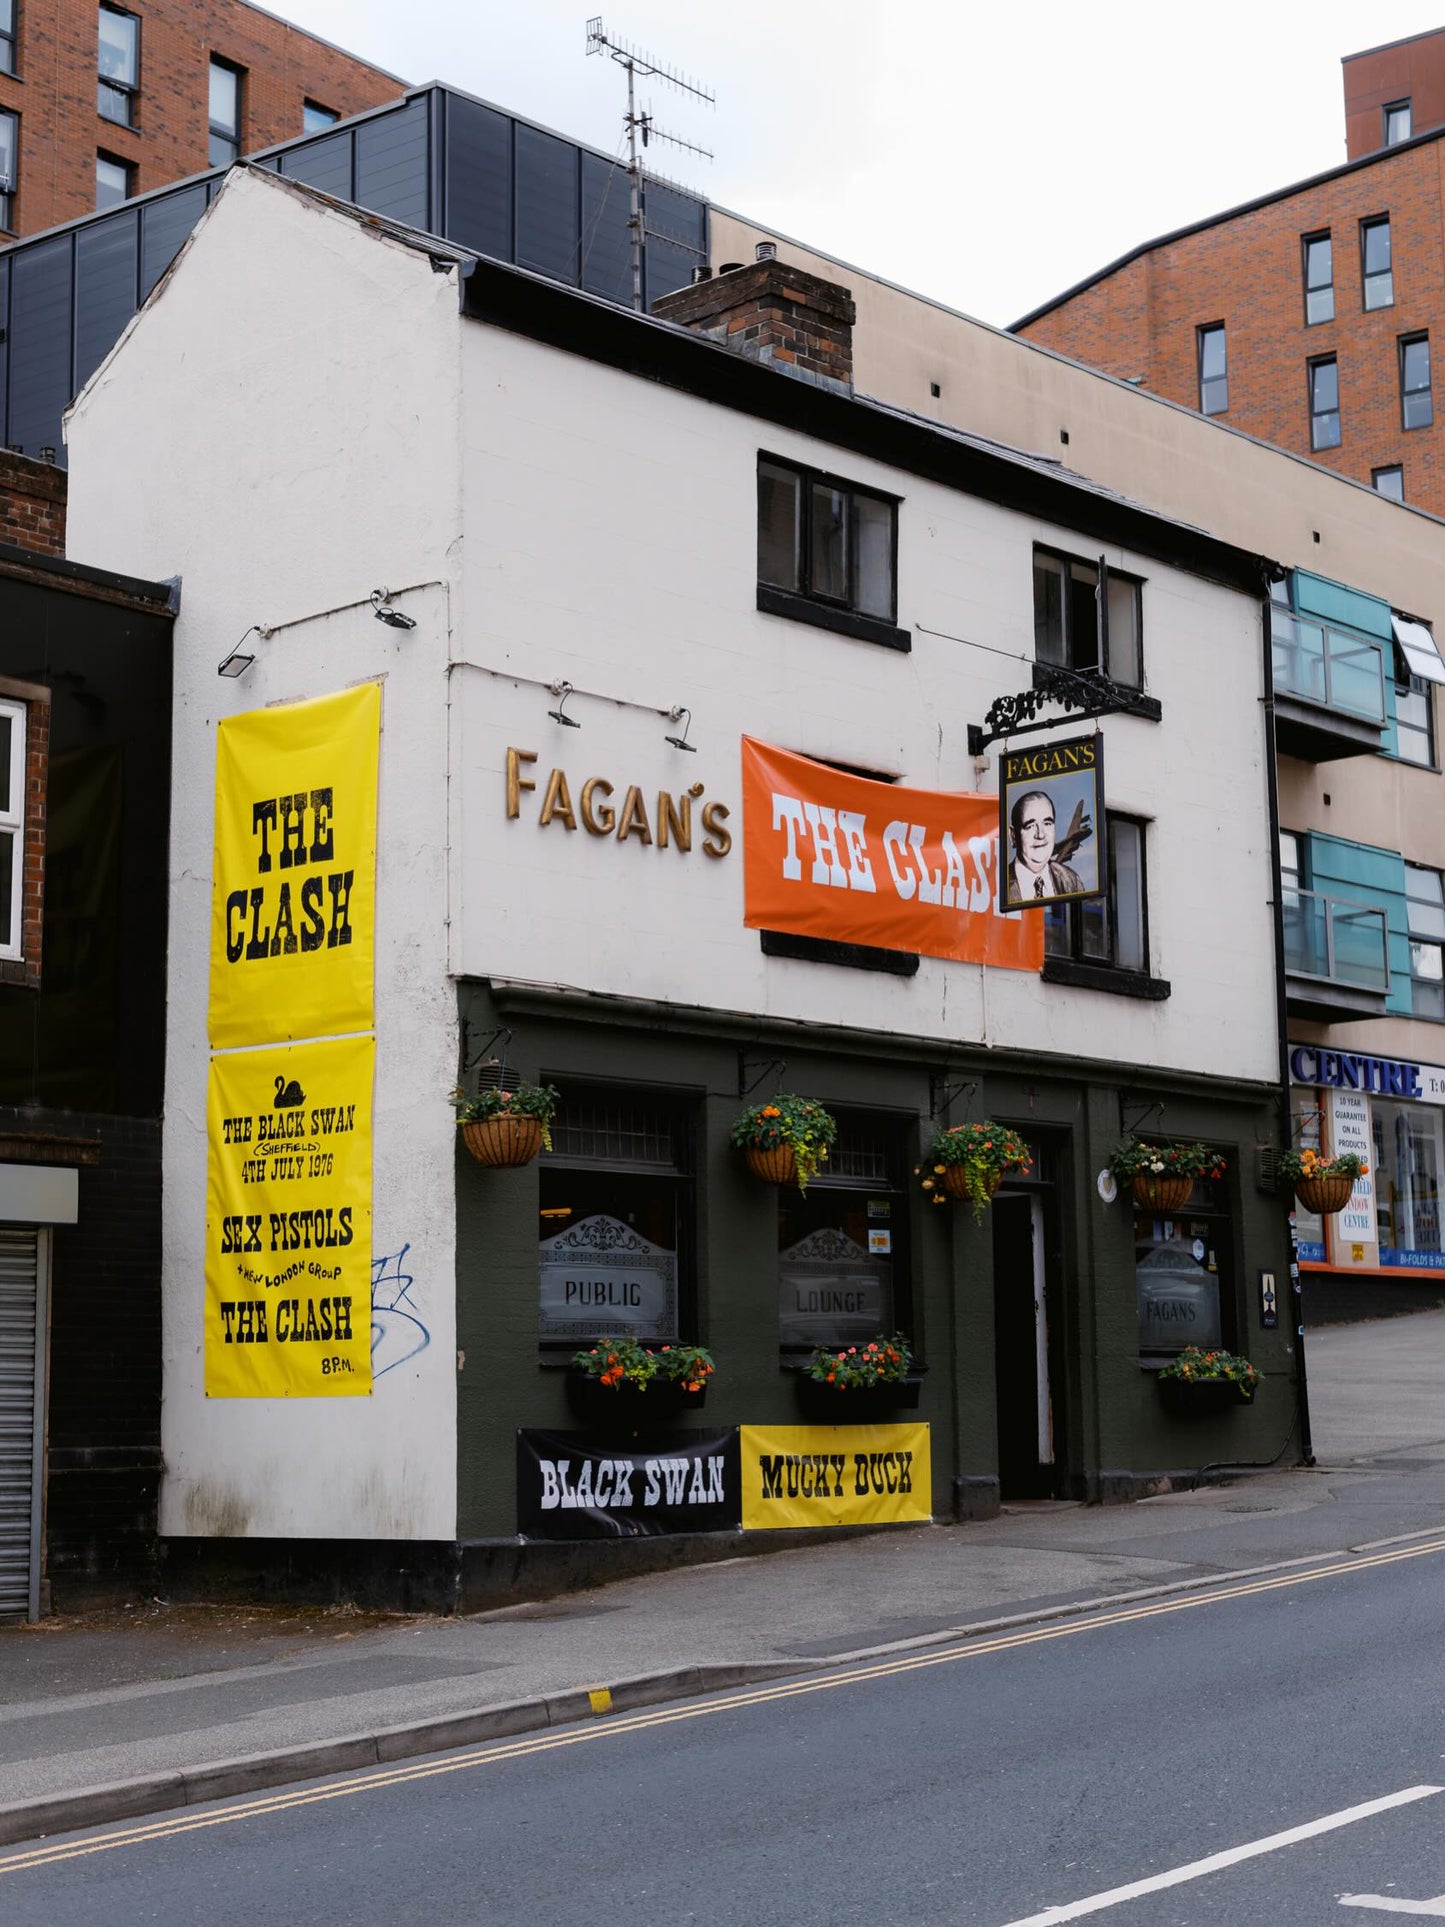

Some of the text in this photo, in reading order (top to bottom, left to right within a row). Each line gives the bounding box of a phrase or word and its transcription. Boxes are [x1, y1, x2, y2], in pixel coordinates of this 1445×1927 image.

[1007, 744, 1095, 779] FAGAN'S
[252, 786, 334, 874] THE
[771, 792, 877, 893] THE
[226, 869, 354, 963] CLASH
[1290, 1046, 1423, 1098] CENTRE
[1335, 1110, 1367, 1122] GUARANTEE
[1339, 1096, 1361, 1107] 10 YEAR
[223, 1104, 356, 1144] THE BLACK SWAN
[1342, 1125, 1361, 1135] ON ALL
[1338, 1139, 1367, 1149] PRODUCTS
[241, 1153, 334, 1184] 4TH JULY 1976
[221, 1207, 353, 1254] SEX PISTOLS
[1344, 1214, 1369, 1229] CENTRE
[243, 1267, 263, 1284] NEW
[265, 1260, 305, 1288] LONDON
[565, 1281, 641, 1307] PUBLIC
[796, 1289, 865, 1313] LOUNGE
[220, 1296, 352, 1343] THE CLASH
[1147, 1301, 1196, 1322] FAGANS
[539, 1455, 725, 1509] BLACK SWAN
[759, 1451, 912, 1499] MUCKY DUCK
